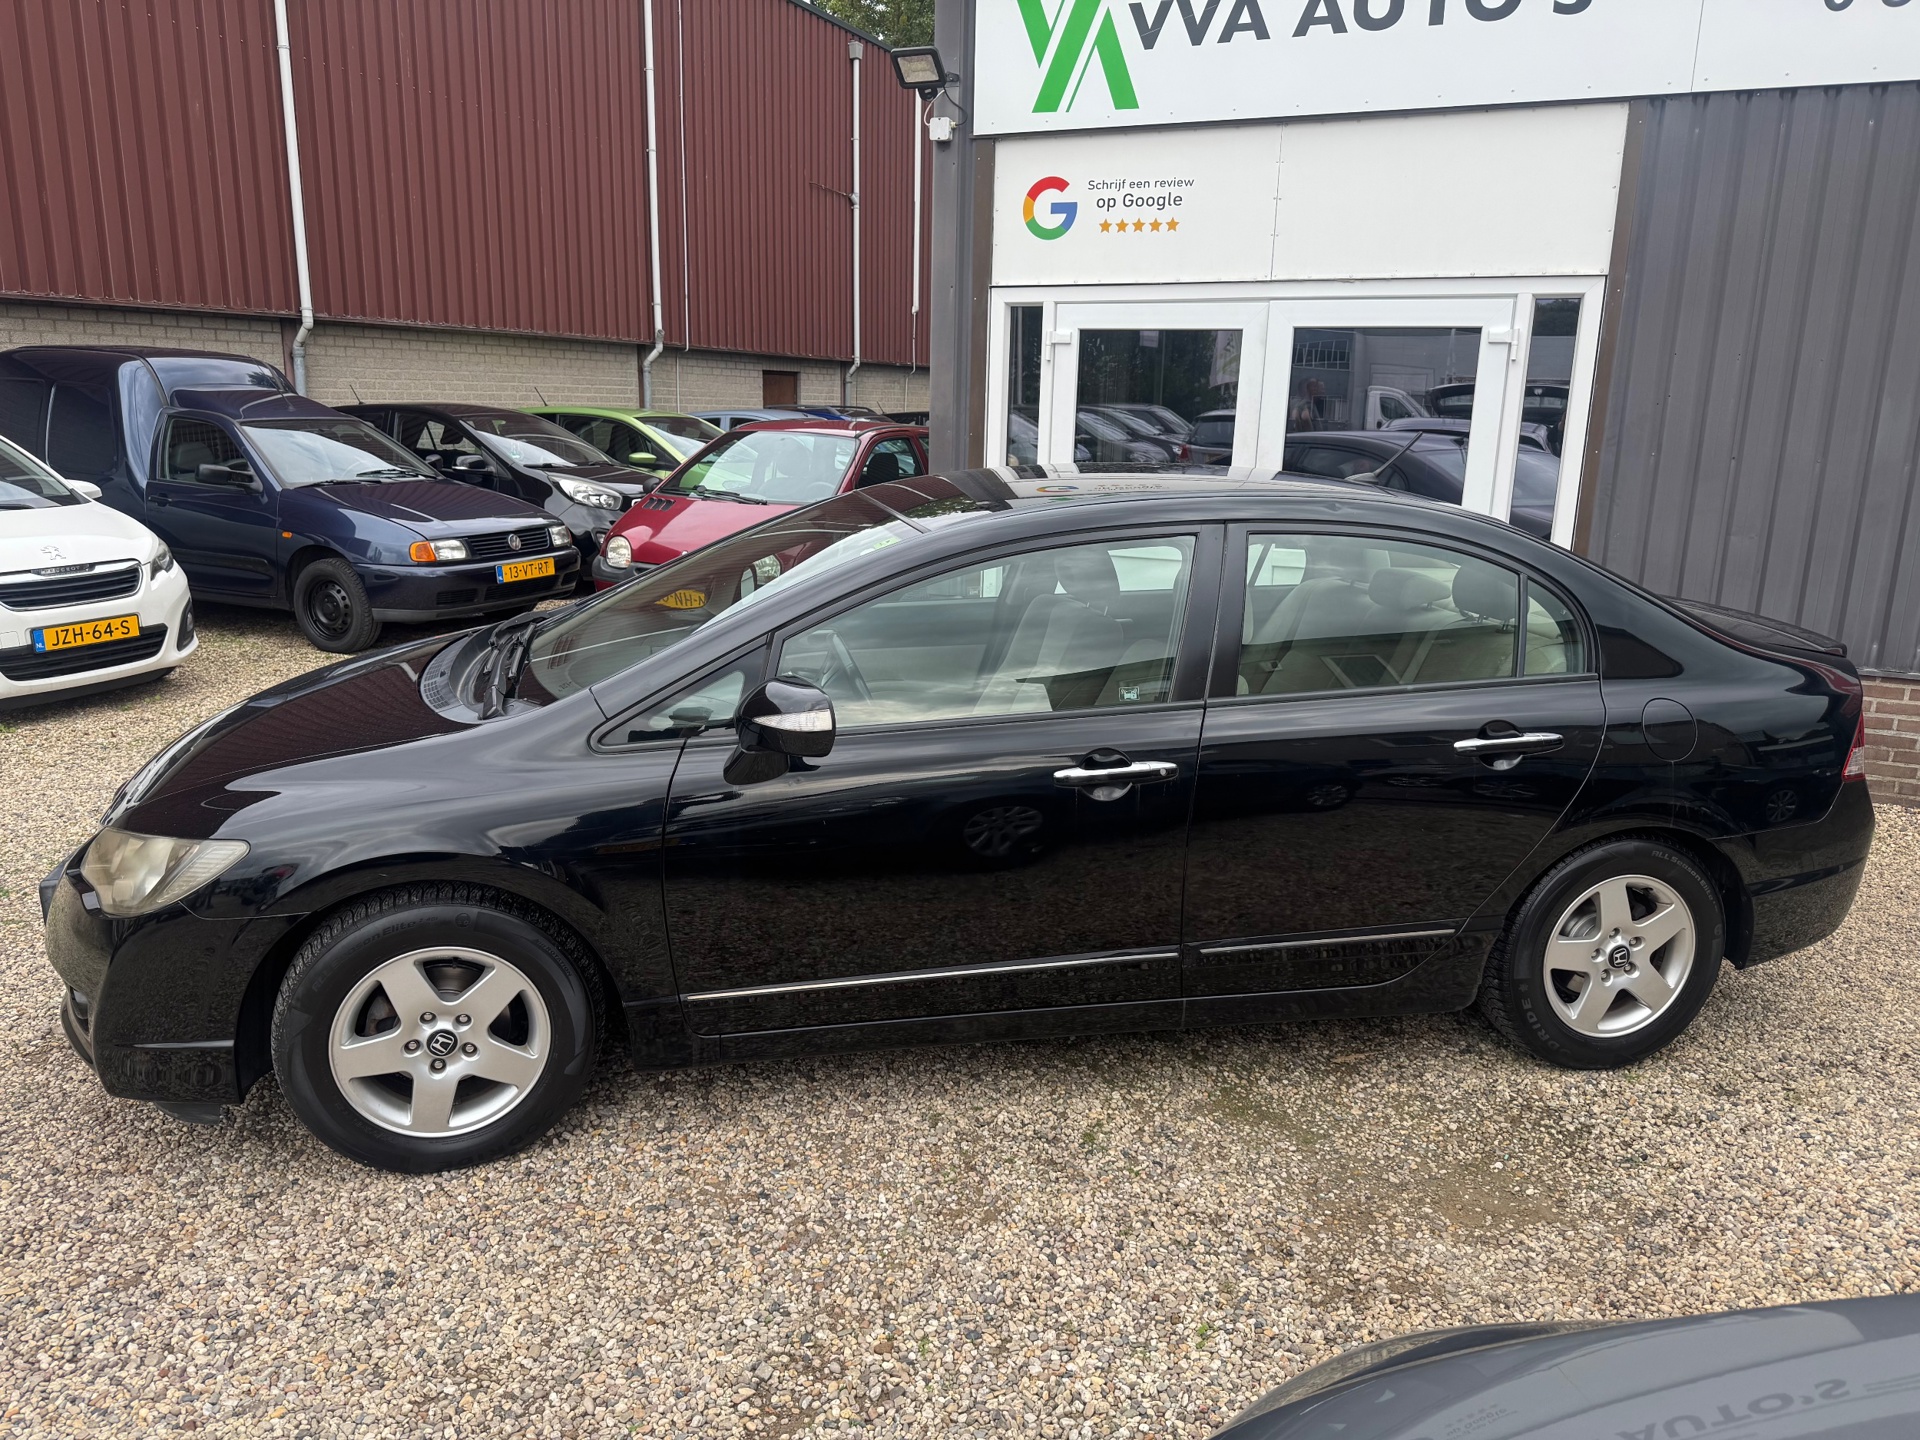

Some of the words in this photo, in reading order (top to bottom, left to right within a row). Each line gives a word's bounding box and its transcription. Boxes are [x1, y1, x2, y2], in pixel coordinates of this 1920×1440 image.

[1292, 0, 1592, 38] AUT
[1087, 178, 1127, 192] Schrijf
[1129, 180, 1150, 189] een
[1154, 177, 1195, 188] review
[1096, 197, 1117, 212] op
[1122, 192, 1183, 211] Google
[508, 561, 549, 579] 13-VT-RT
[52, 620, 131, 646] JZH-64-S
